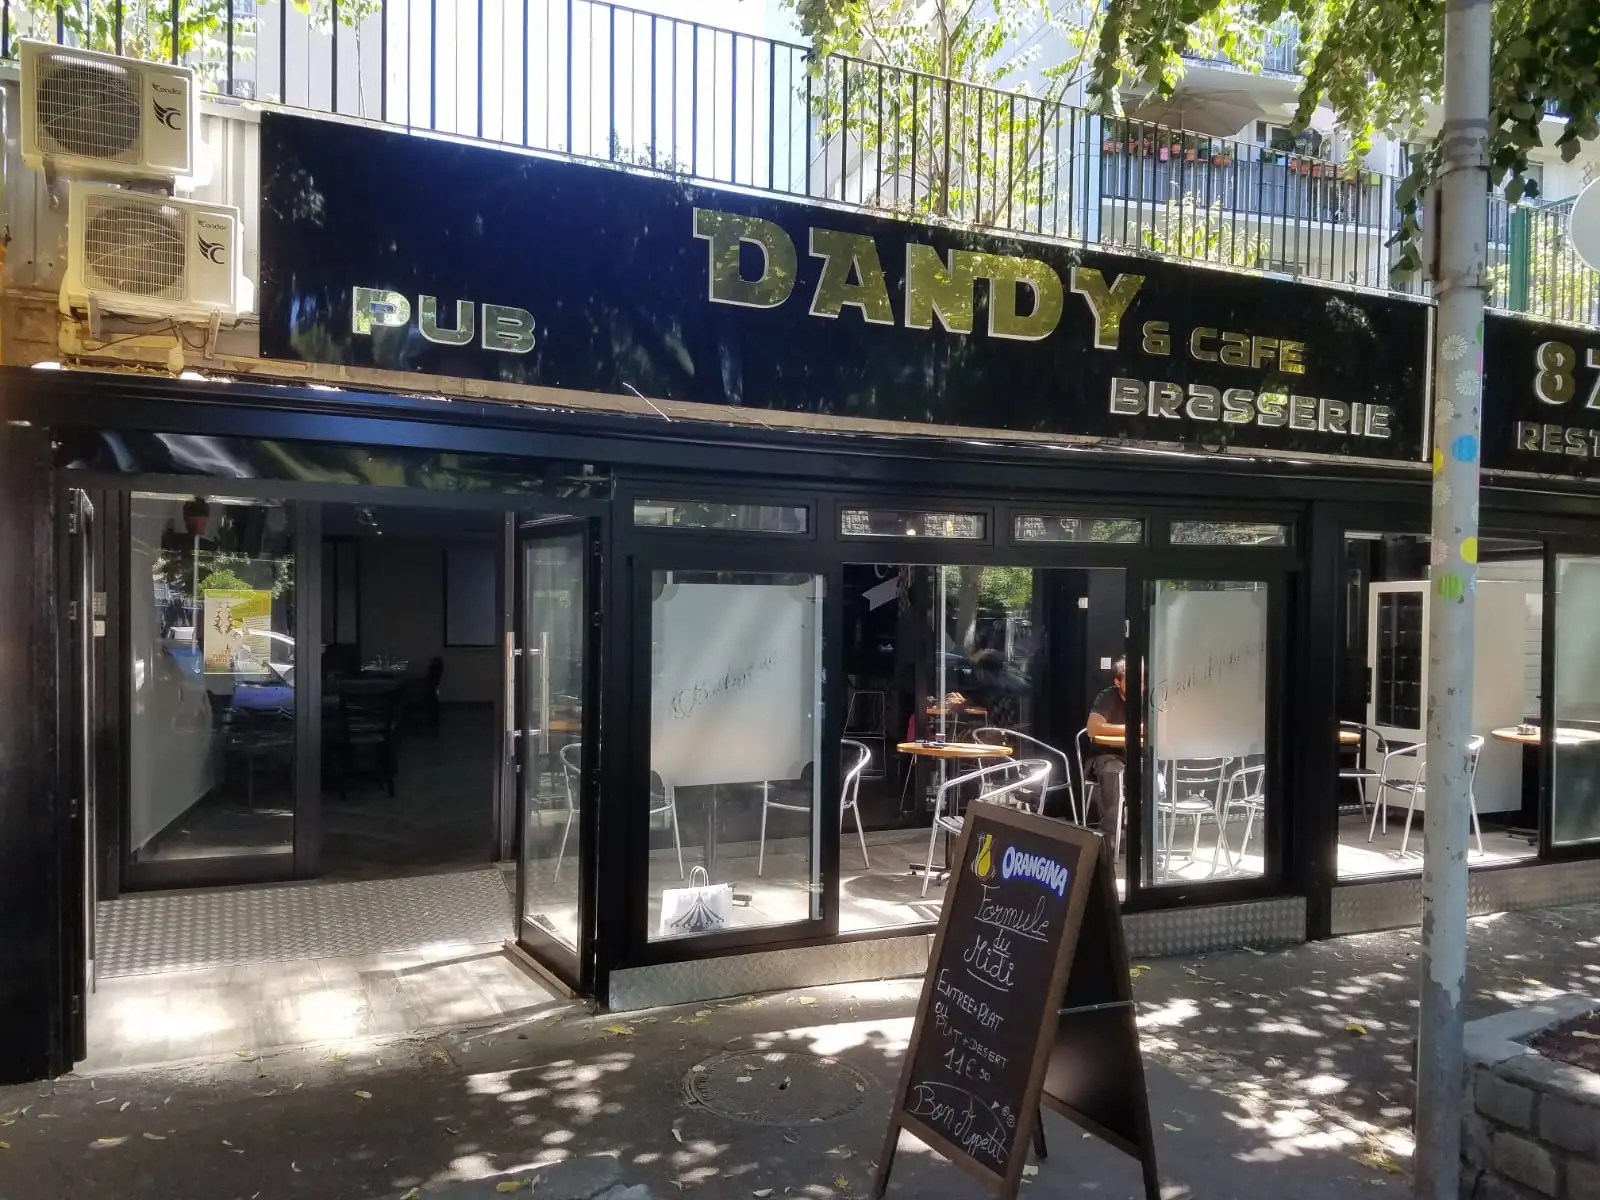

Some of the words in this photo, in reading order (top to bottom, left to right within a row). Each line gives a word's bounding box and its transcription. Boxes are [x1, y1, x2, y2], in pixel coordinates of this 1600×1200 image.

[691, 206, 1147, 351] DANDY
[351, 285, 537, 354] PUB
[1142, 320, 1171, 356] &
[1002, 846, 1069, 898] ORANGINA
[963, 935, 1015, 987] Midi
[992, 929, 1012, 955] du
